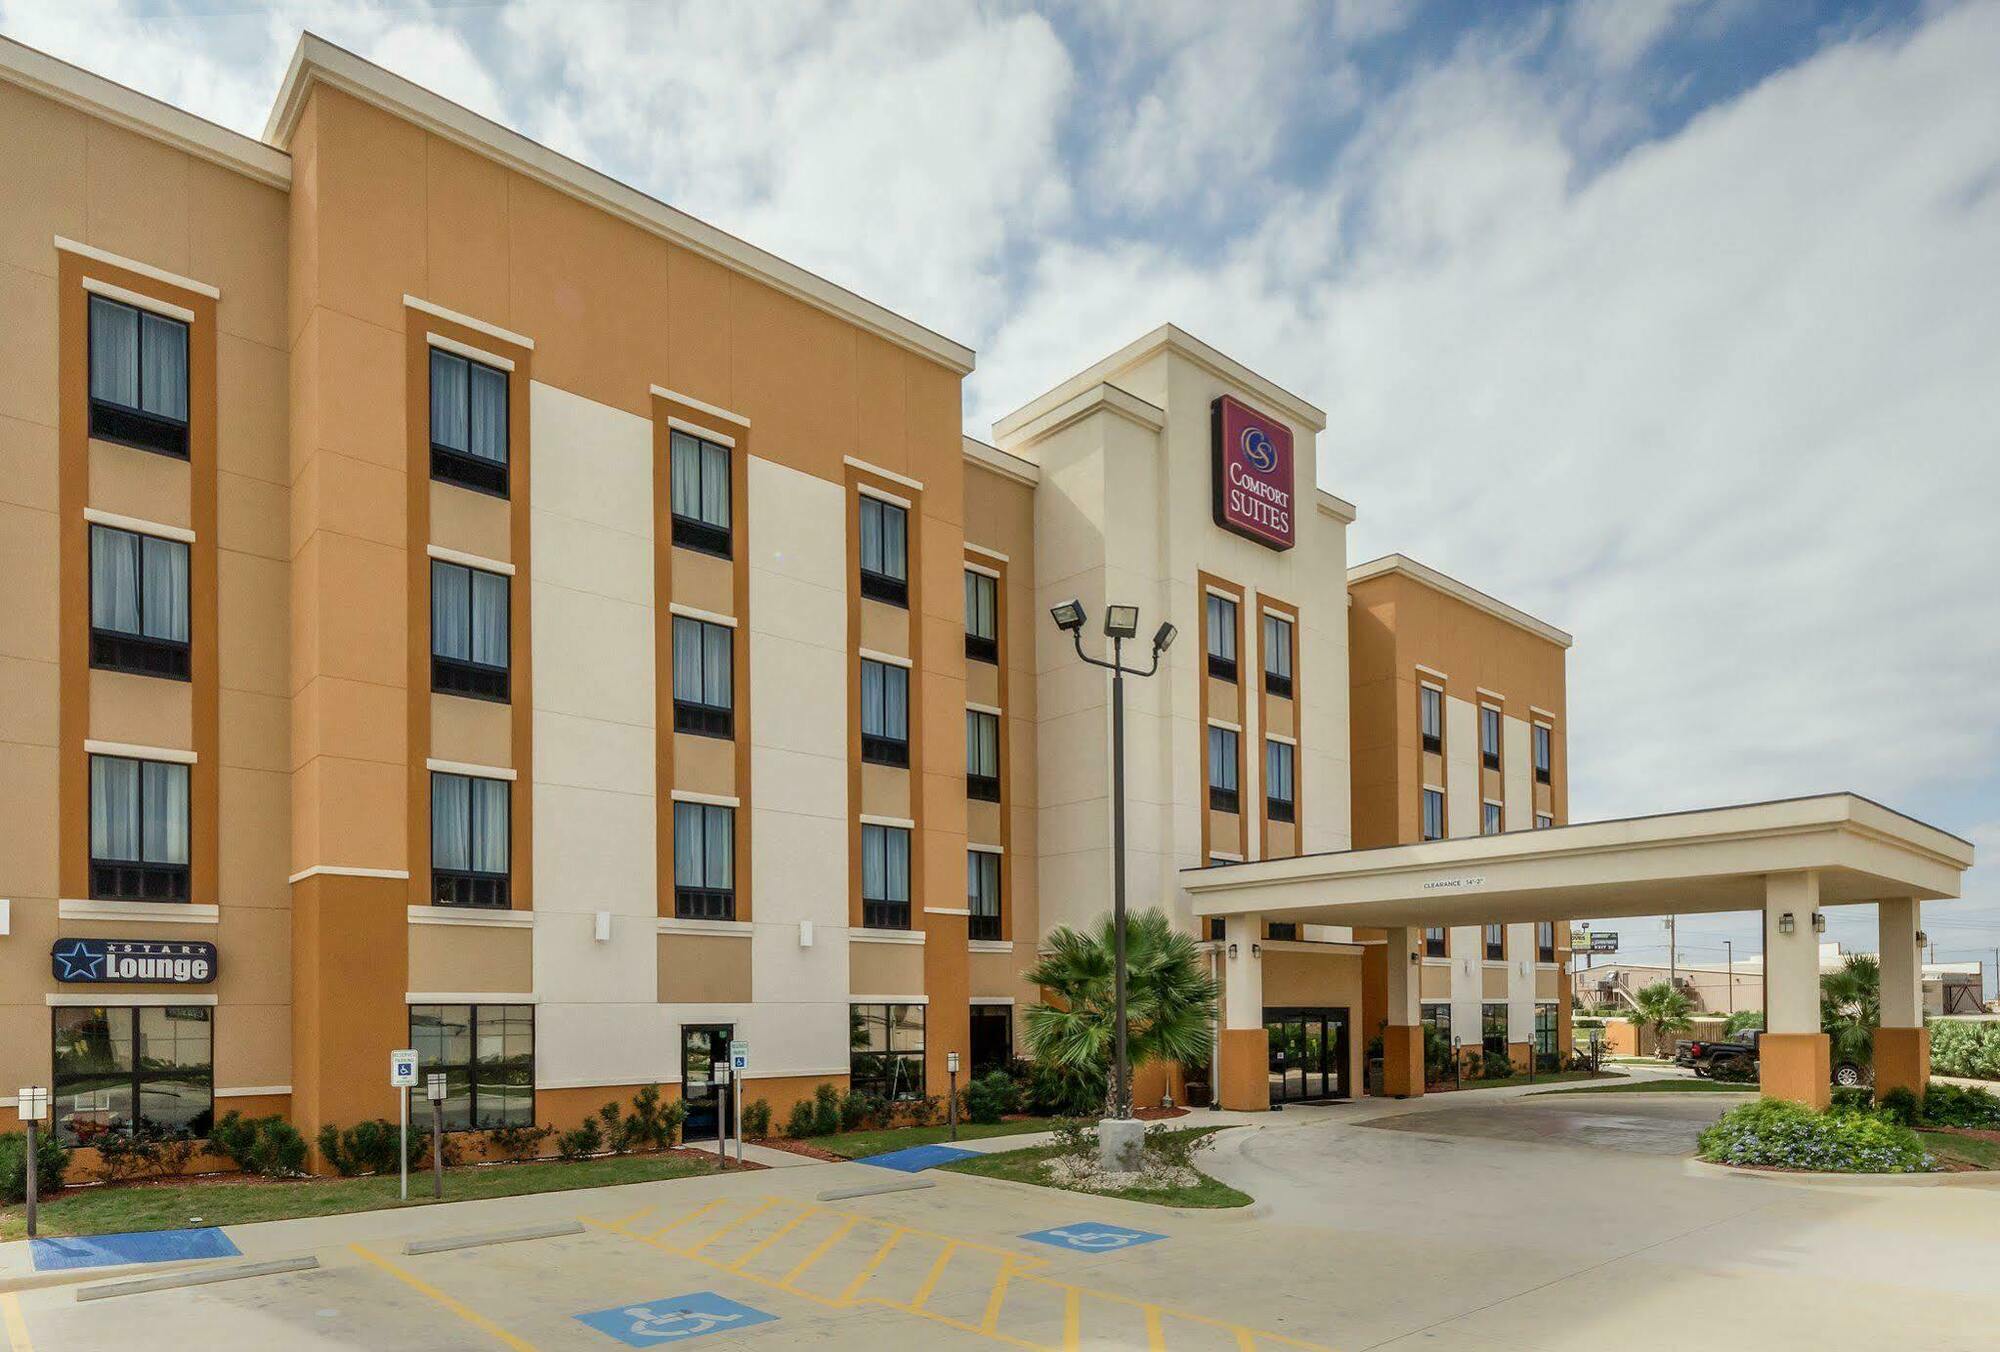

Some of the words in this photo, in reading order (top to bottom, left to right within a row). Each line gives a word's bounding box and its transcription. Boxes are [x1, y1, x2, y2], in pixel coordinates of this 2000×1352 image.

[1230, 462, 1289, 508] COMFORT
[1231, 489, 1289, 534] SUITES
[1423, 880, 1461, 889] CLEARANCE
[123, 944, 190, 954] STAR
[106, 954, 209, 982] Lounge
